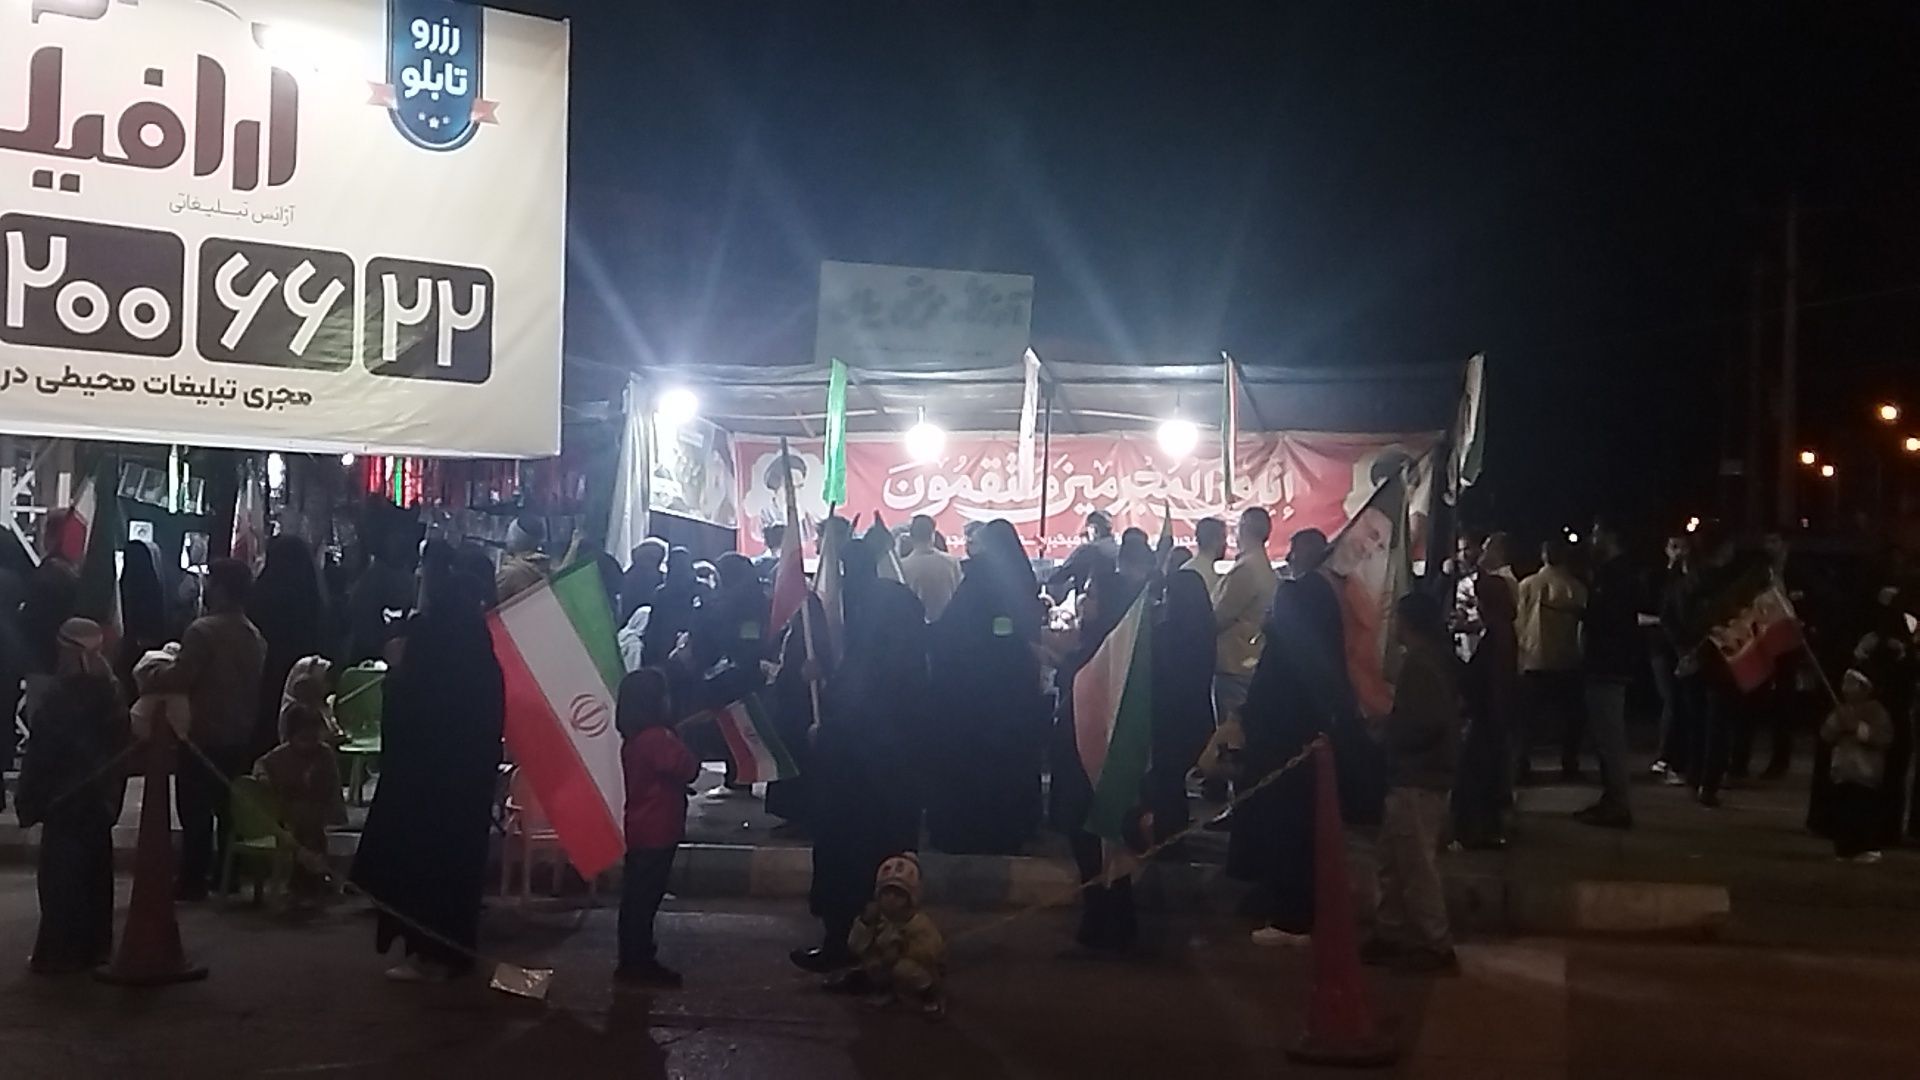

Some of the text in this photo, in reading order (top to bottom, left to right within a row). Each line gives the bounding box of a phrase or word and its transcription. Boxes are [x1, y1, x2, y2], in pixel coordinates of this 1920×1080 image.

[410, 18, 460, 56] رزرو
[401, 58, 468, 101] تابلو
[251, 204, 296, 227] آژانس
[0, 365, 313, 411] مجری تبلیغات محیطی در
